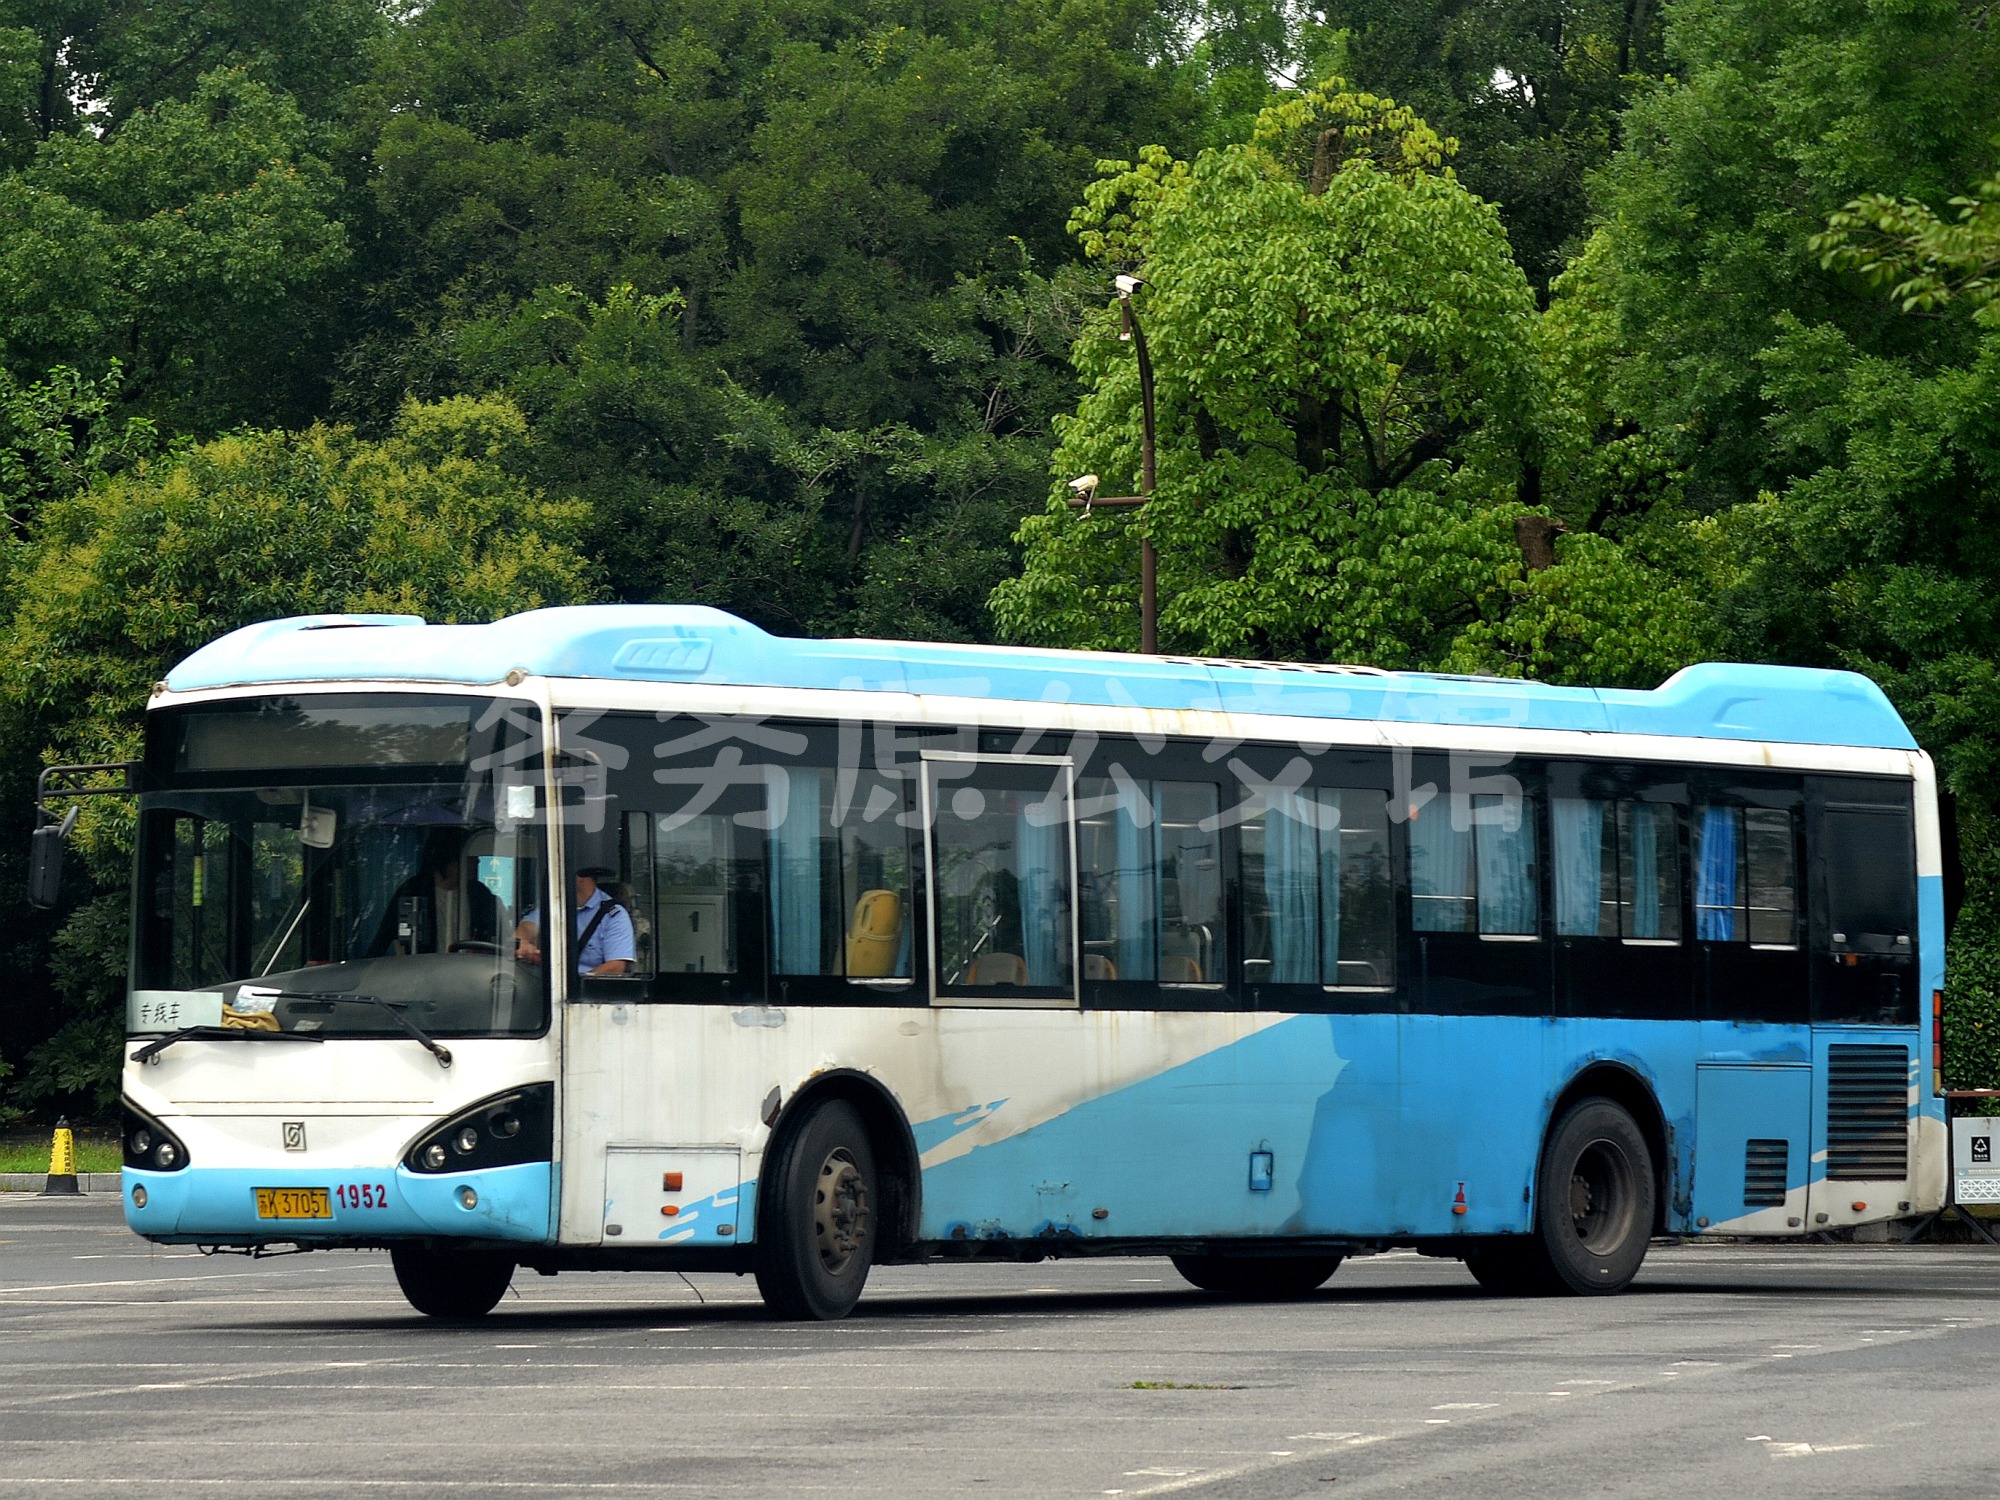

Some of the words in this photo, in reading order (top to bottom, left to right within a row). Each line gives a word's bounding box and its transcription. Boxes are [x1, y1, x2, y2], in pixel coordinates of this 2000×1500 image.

[140, 1001, 181, 1025] 专线车
[336, 1184, 388, 1209] 1952
